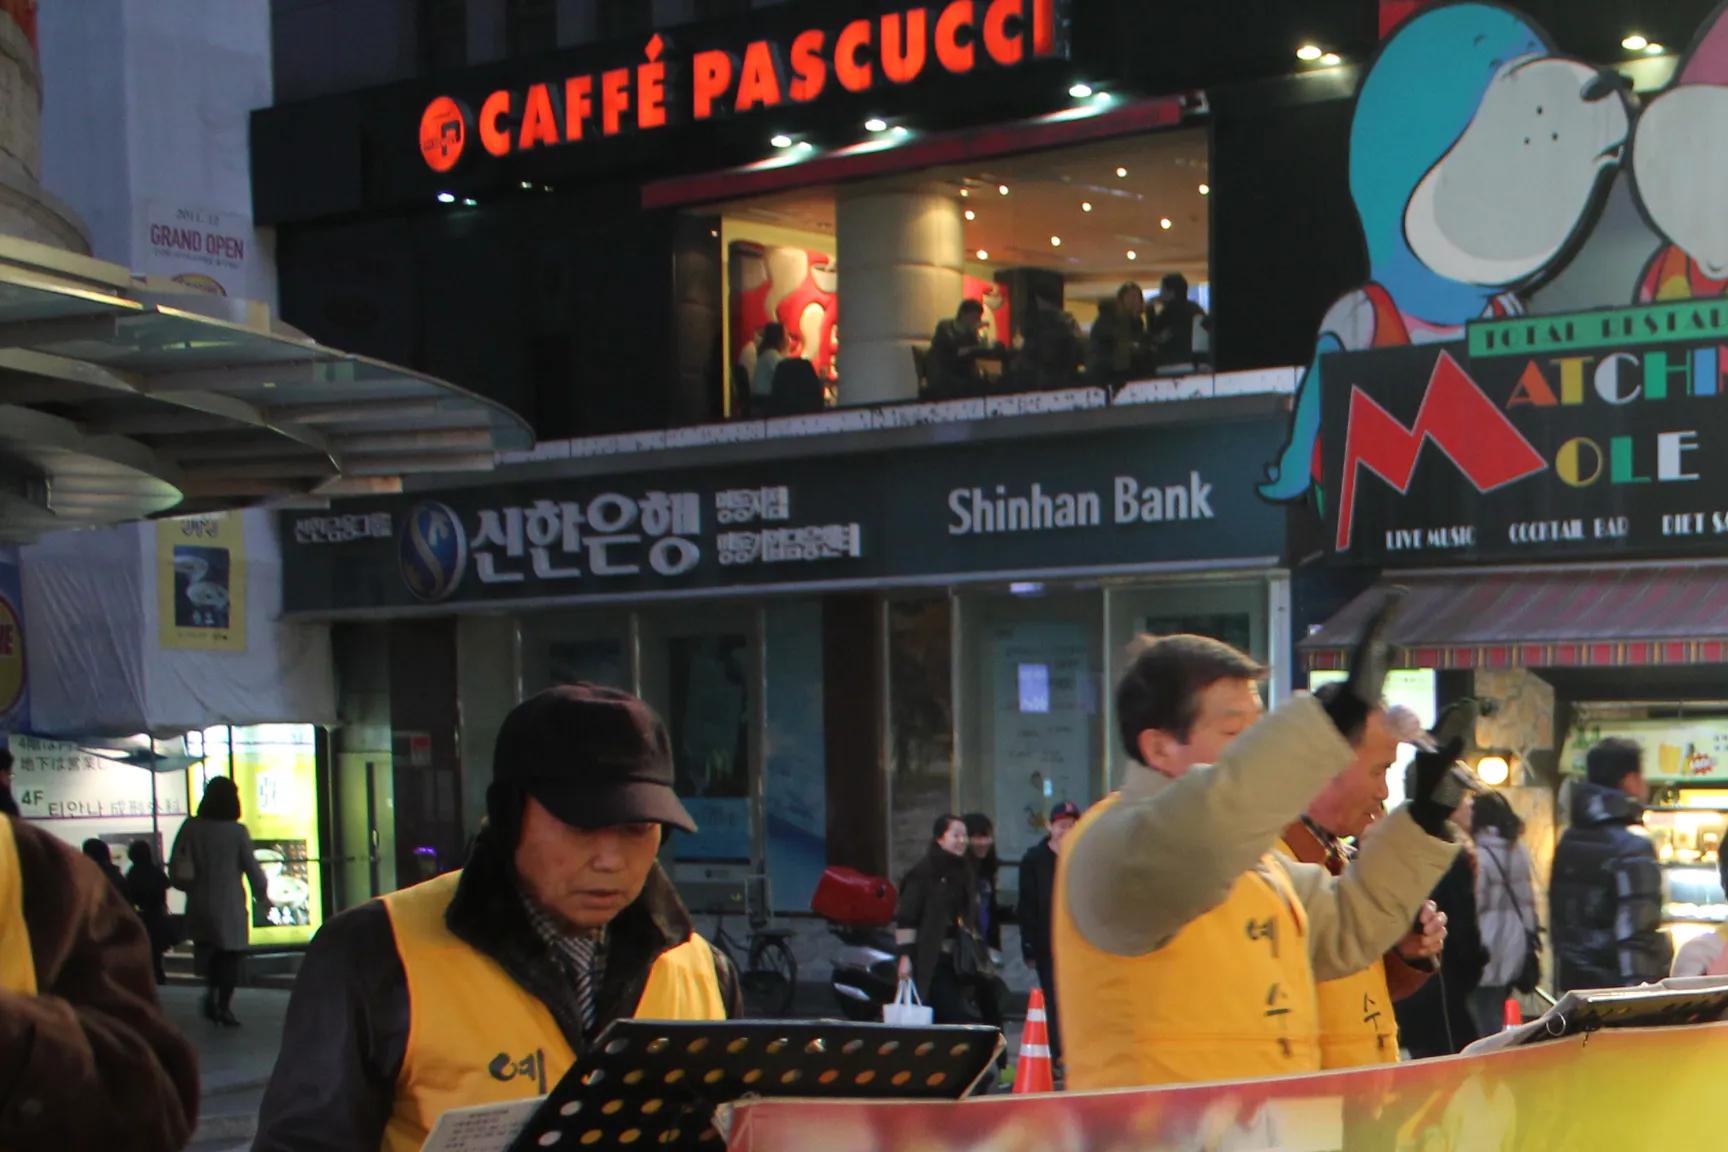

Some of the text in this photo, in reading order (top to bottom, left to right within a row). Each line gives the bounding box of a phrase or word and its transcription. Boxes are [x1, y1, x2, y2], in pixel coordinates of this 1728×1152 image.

[479, 0, 1055, 156] CAFFÉ PASCUCCI
[150, 223, 202, 252] GRAND
[206, 233, 244, 260] OPEN
[1485, 321, 1577, 349] TOTAL
[949, 470, 1214, 534] Shinhan Bank
[472, 492, 700, 584] 신한은행
[1386, 525, 1475, 550] LIVE MUSIC
[1508, 516, 1628, 543] COCKTAIL BAR
[1662, 512, 1704, 536] DIET
[21, 790, 44, 805] 4F
